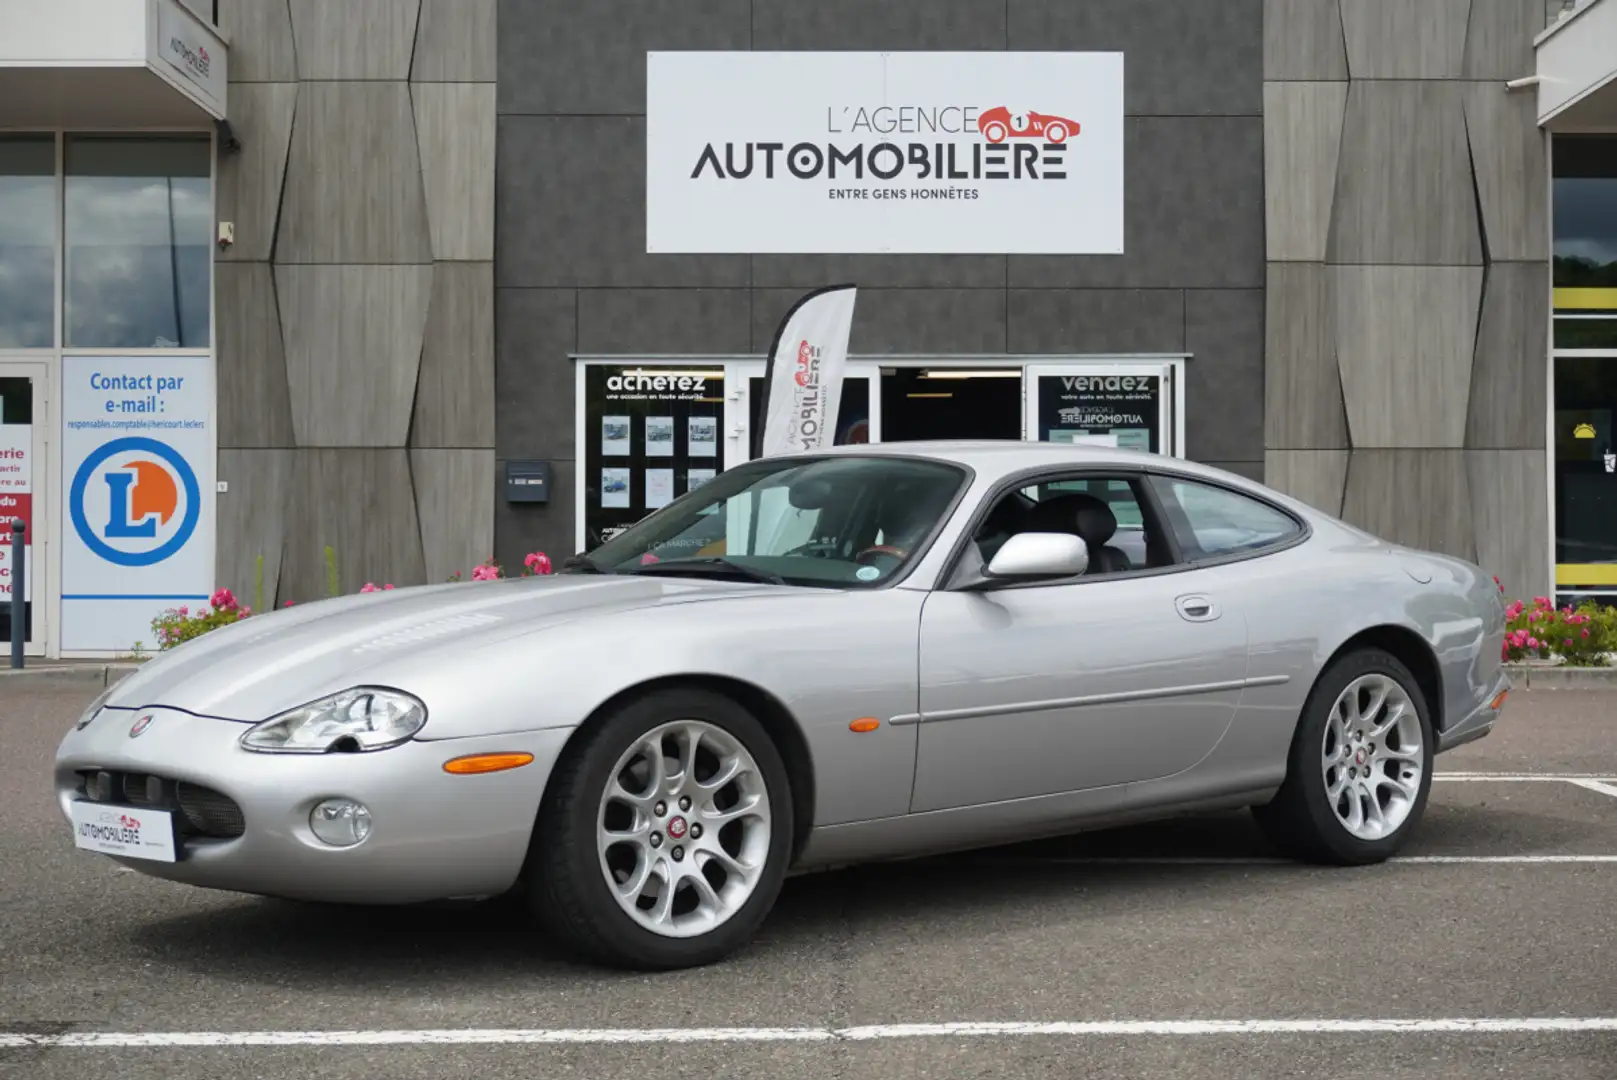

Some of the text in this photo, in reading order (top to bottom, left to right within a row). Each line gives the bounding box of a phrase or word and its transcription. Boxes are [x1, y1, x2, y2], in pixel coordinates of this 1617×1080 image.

[828, 106, 979, 134] L'AGENCE
[690, 142, 1067, 179] AUTOMOBILIERE
[829, 185, 979, 200] ENTRE GENS HONNÊTES
[90, 373, 184, 394] Contact par
[606, 367, 705, 391] achetez
[1061, 375, 1150, 391] vendez
[105, 396, 156, 412] e-mail
